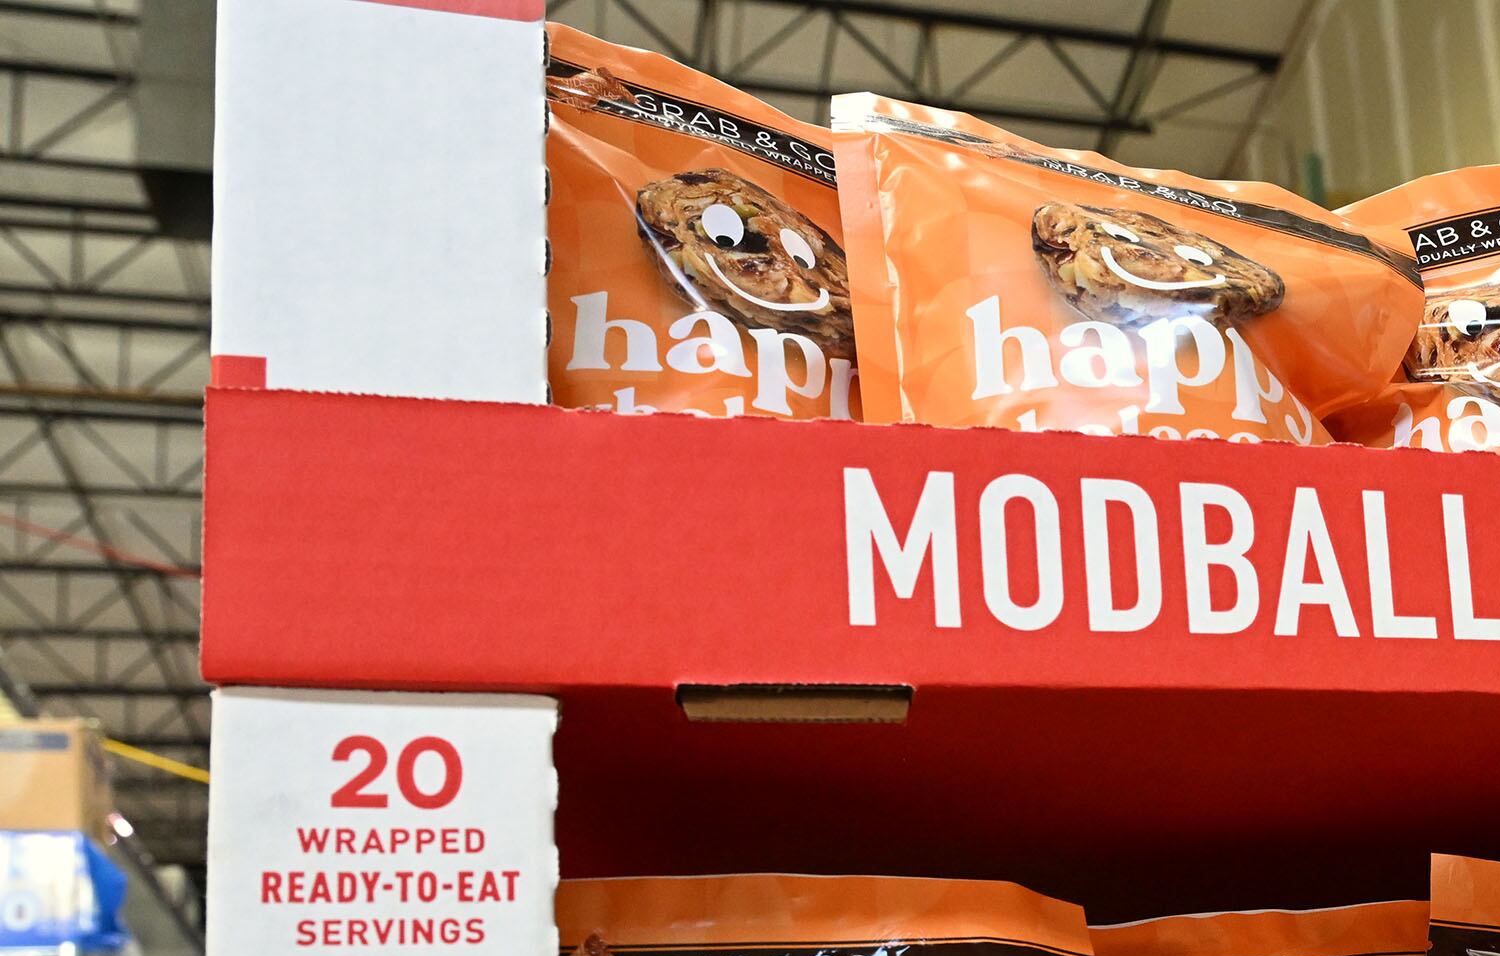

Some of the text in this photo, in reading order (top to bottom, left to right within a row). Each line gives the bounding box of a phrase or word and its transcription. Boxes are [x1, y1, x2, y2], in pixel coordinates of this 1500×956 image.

[633, 93, 741, 140] GRAB
[756, 131, 779, 151] &
[790, 142, 837, 172] GO
[1470, 219, 1493, 238] &
[331, 735, 463, 810] 20
[297, 828, 486, 854] WRAPPED
[260, 871, 521, 904] READY-TO-EAT
[296, 918, 486, 946] SERVINGS
